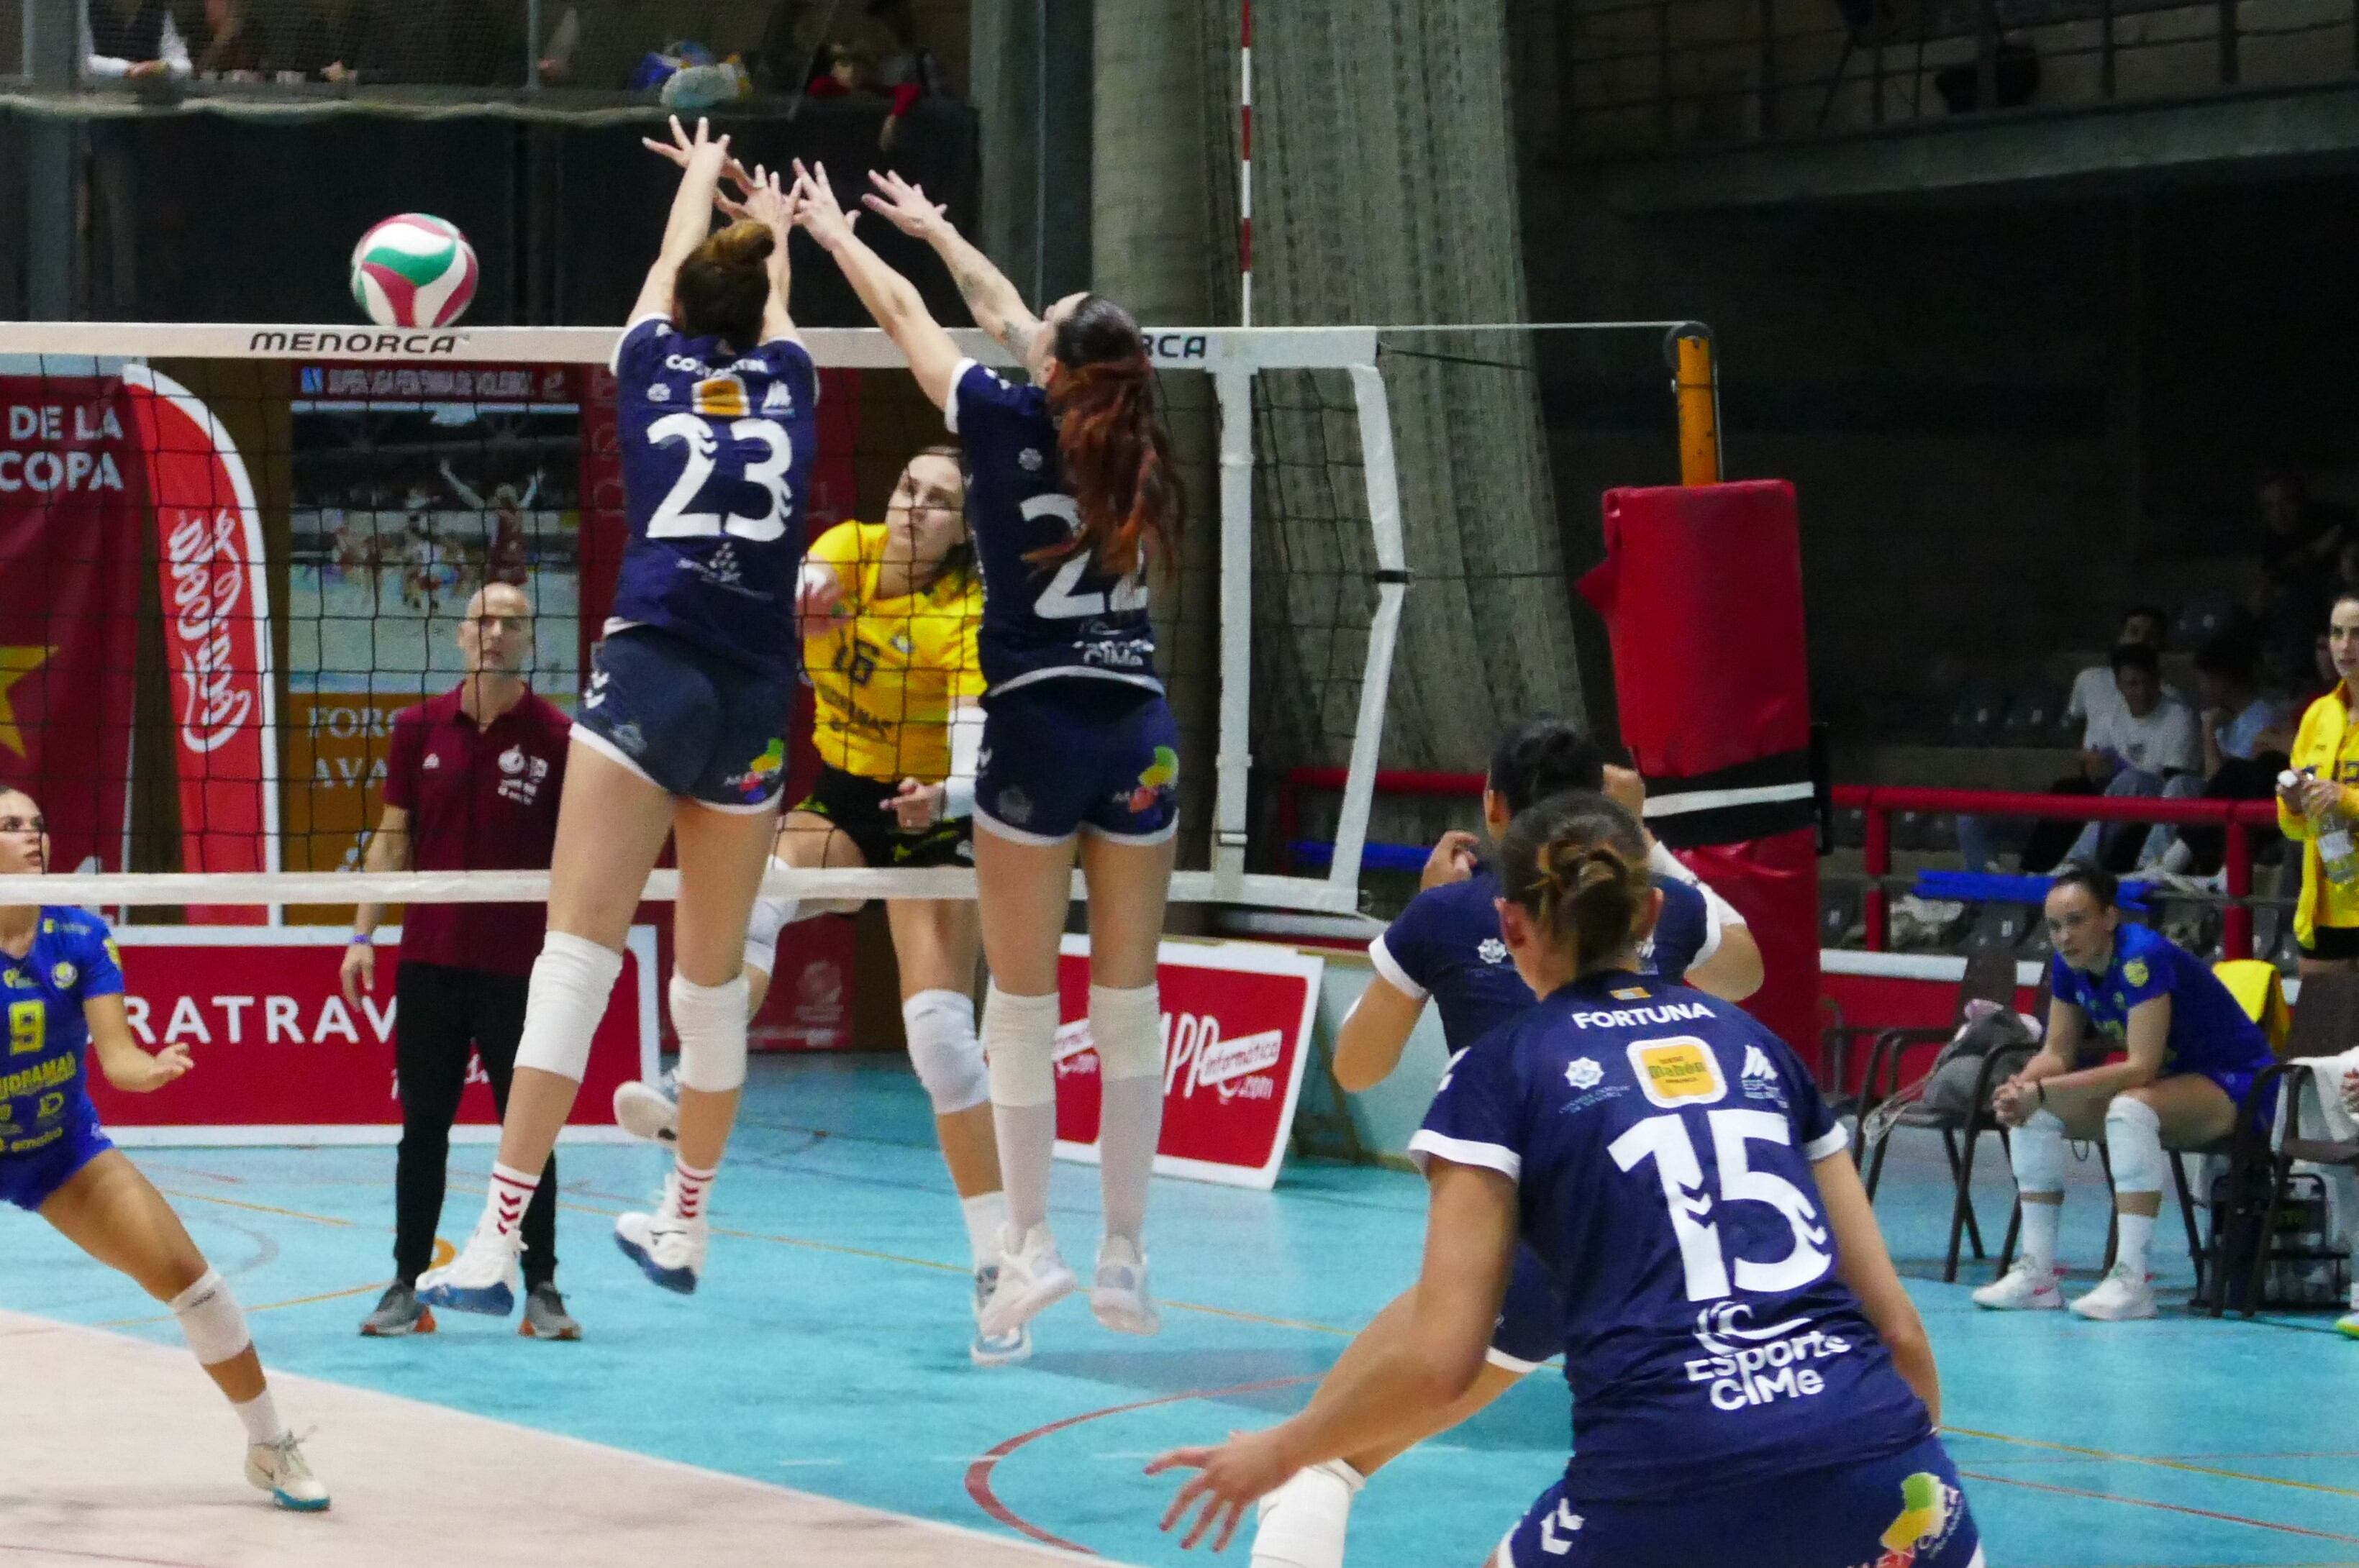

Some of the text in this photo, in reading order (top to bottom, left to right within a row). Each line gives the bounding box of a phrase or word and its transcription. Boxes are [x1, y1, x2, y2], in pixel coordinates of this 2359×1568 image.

[250, 332, 457, 353] MENORCA
[9, 405, 123, 441] DE LA
[0, 450, 124, 492] COPA
[647, 414, 792, 542] 23
[9, 999, 45, 1056] 9
[86, 995, 397, 1043] RATRAV
[1571, 1003, 1717, 1029] FORTUNA
[1608, 1108, 1832, 1302] 15
